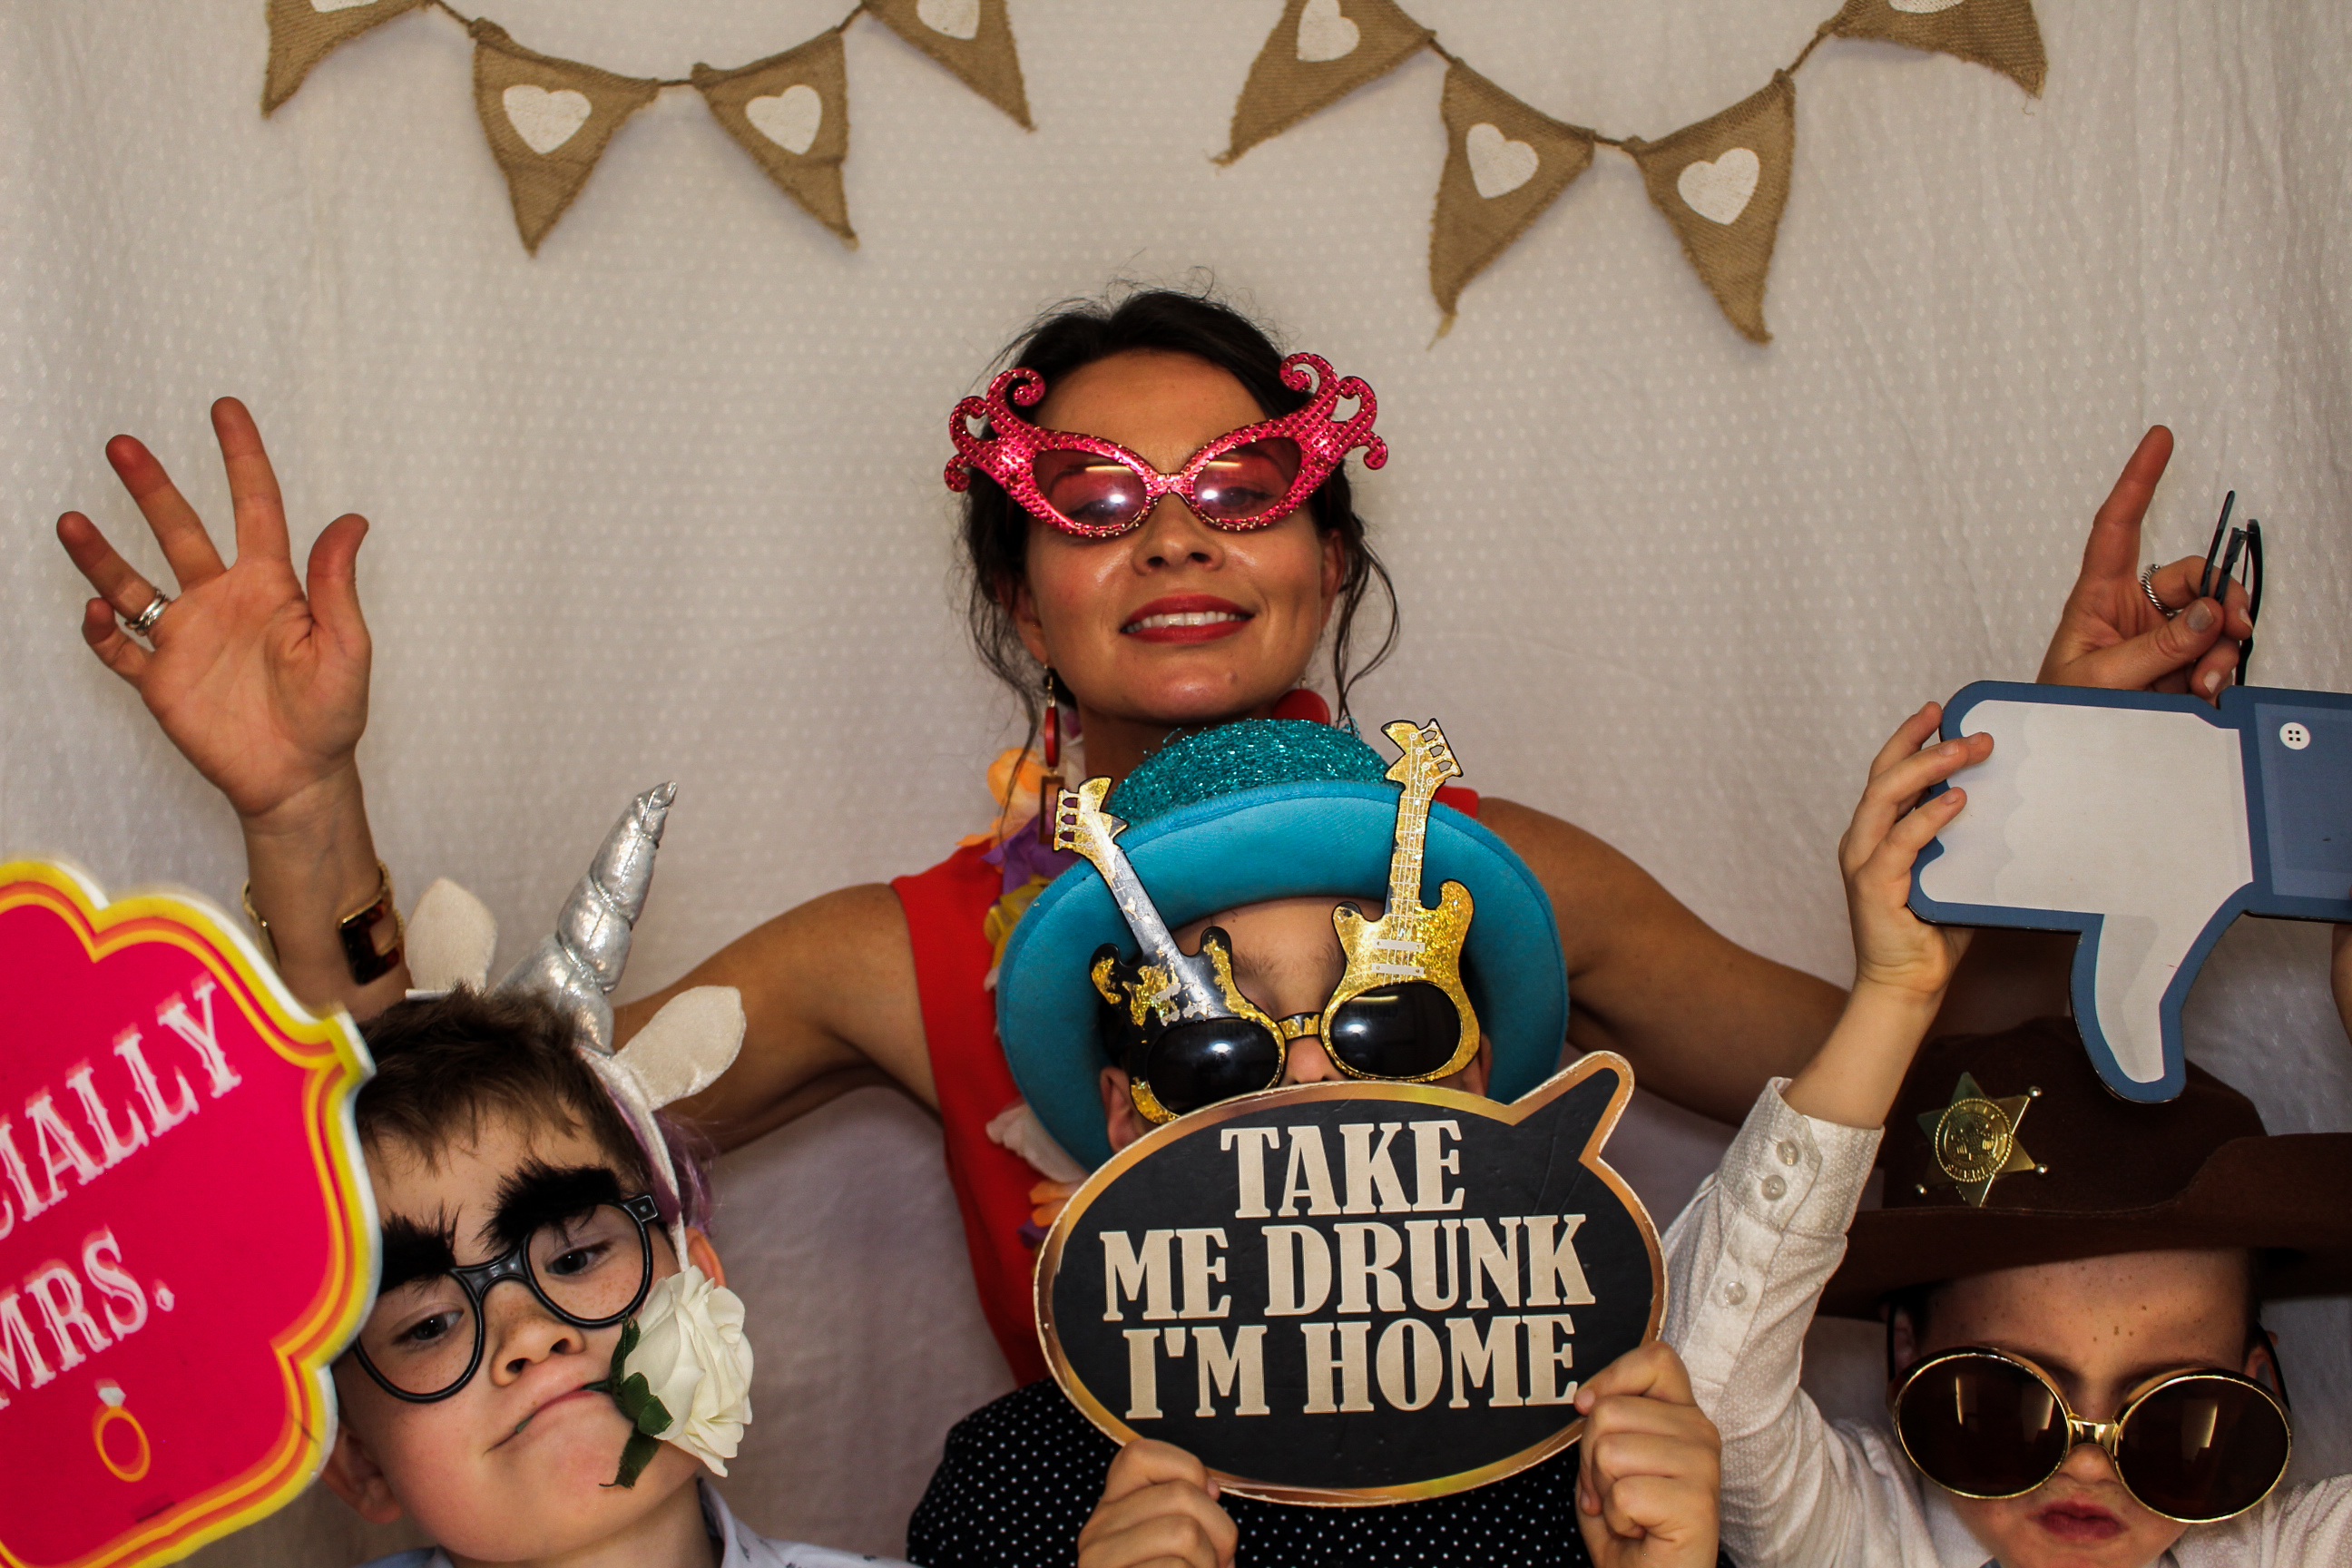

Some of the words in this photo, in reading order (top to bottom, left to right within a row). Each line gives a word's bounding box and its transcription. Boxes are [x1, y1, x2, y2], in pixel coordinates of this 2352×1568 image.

[0, 976, 242, 1240] IALLY
[1220, 1119, 1465, 1219] TAKE
[0, 1228, 175, 1411] MRS.
[1099, 1227, 1232, 1321] ME
[1261, 1213, 1596, 1317] DRUNK
[1122, 1324, 1270, 1420] I'M
[1300, 1313, 1579, 1414] HOME
